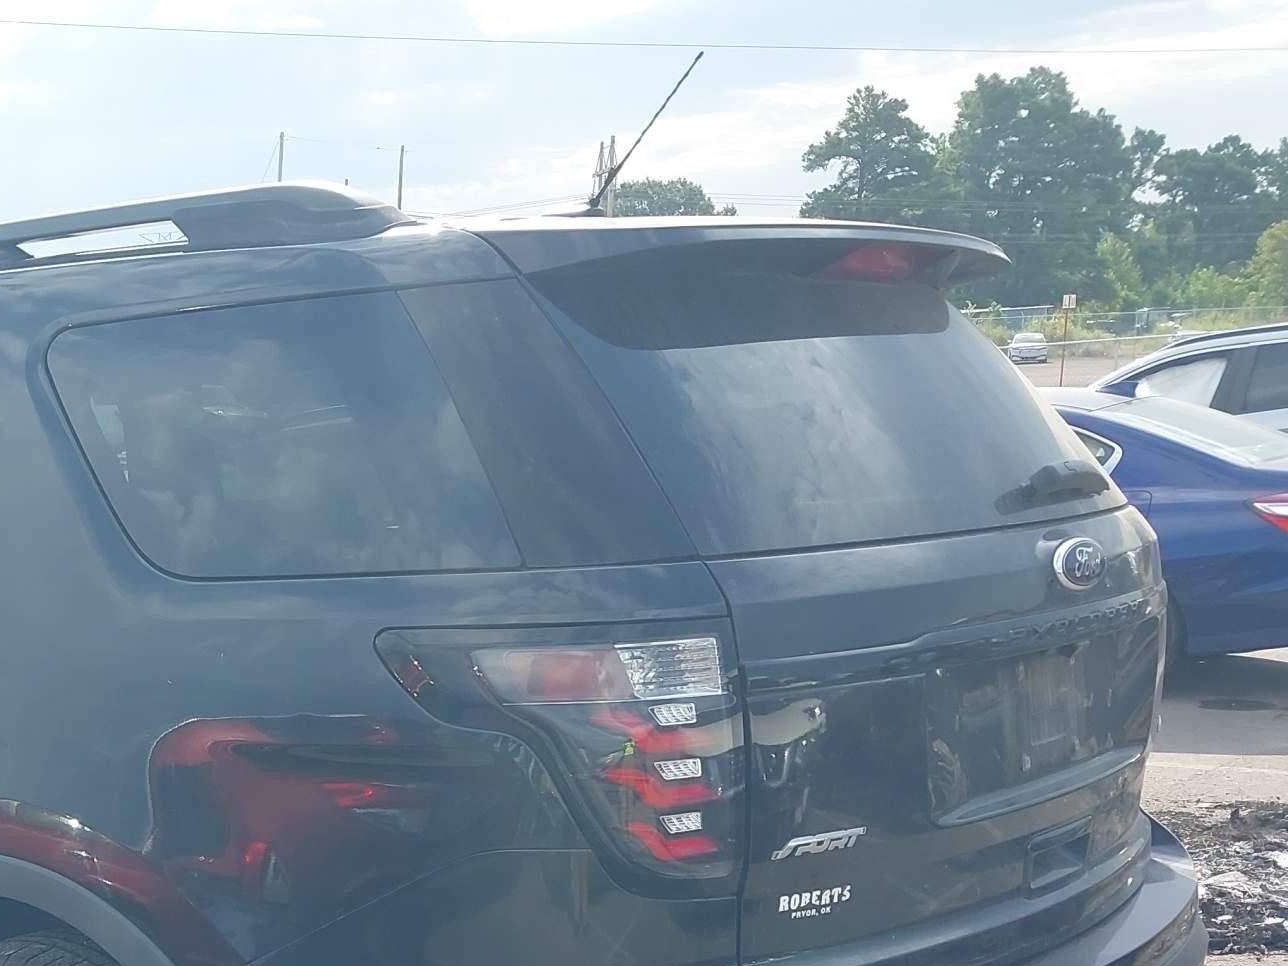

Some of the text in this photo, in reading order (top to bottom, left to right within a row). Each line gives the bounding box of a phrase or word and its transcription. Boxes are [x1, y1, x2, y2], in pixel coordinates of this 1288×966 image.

[1074, 546, 1102, 577] Ford
[770, 826, 867, 860] SPORT
[778, 885, 852, 912] ROBERTS
[791, 905, 832, 920] PRYOR, OK
